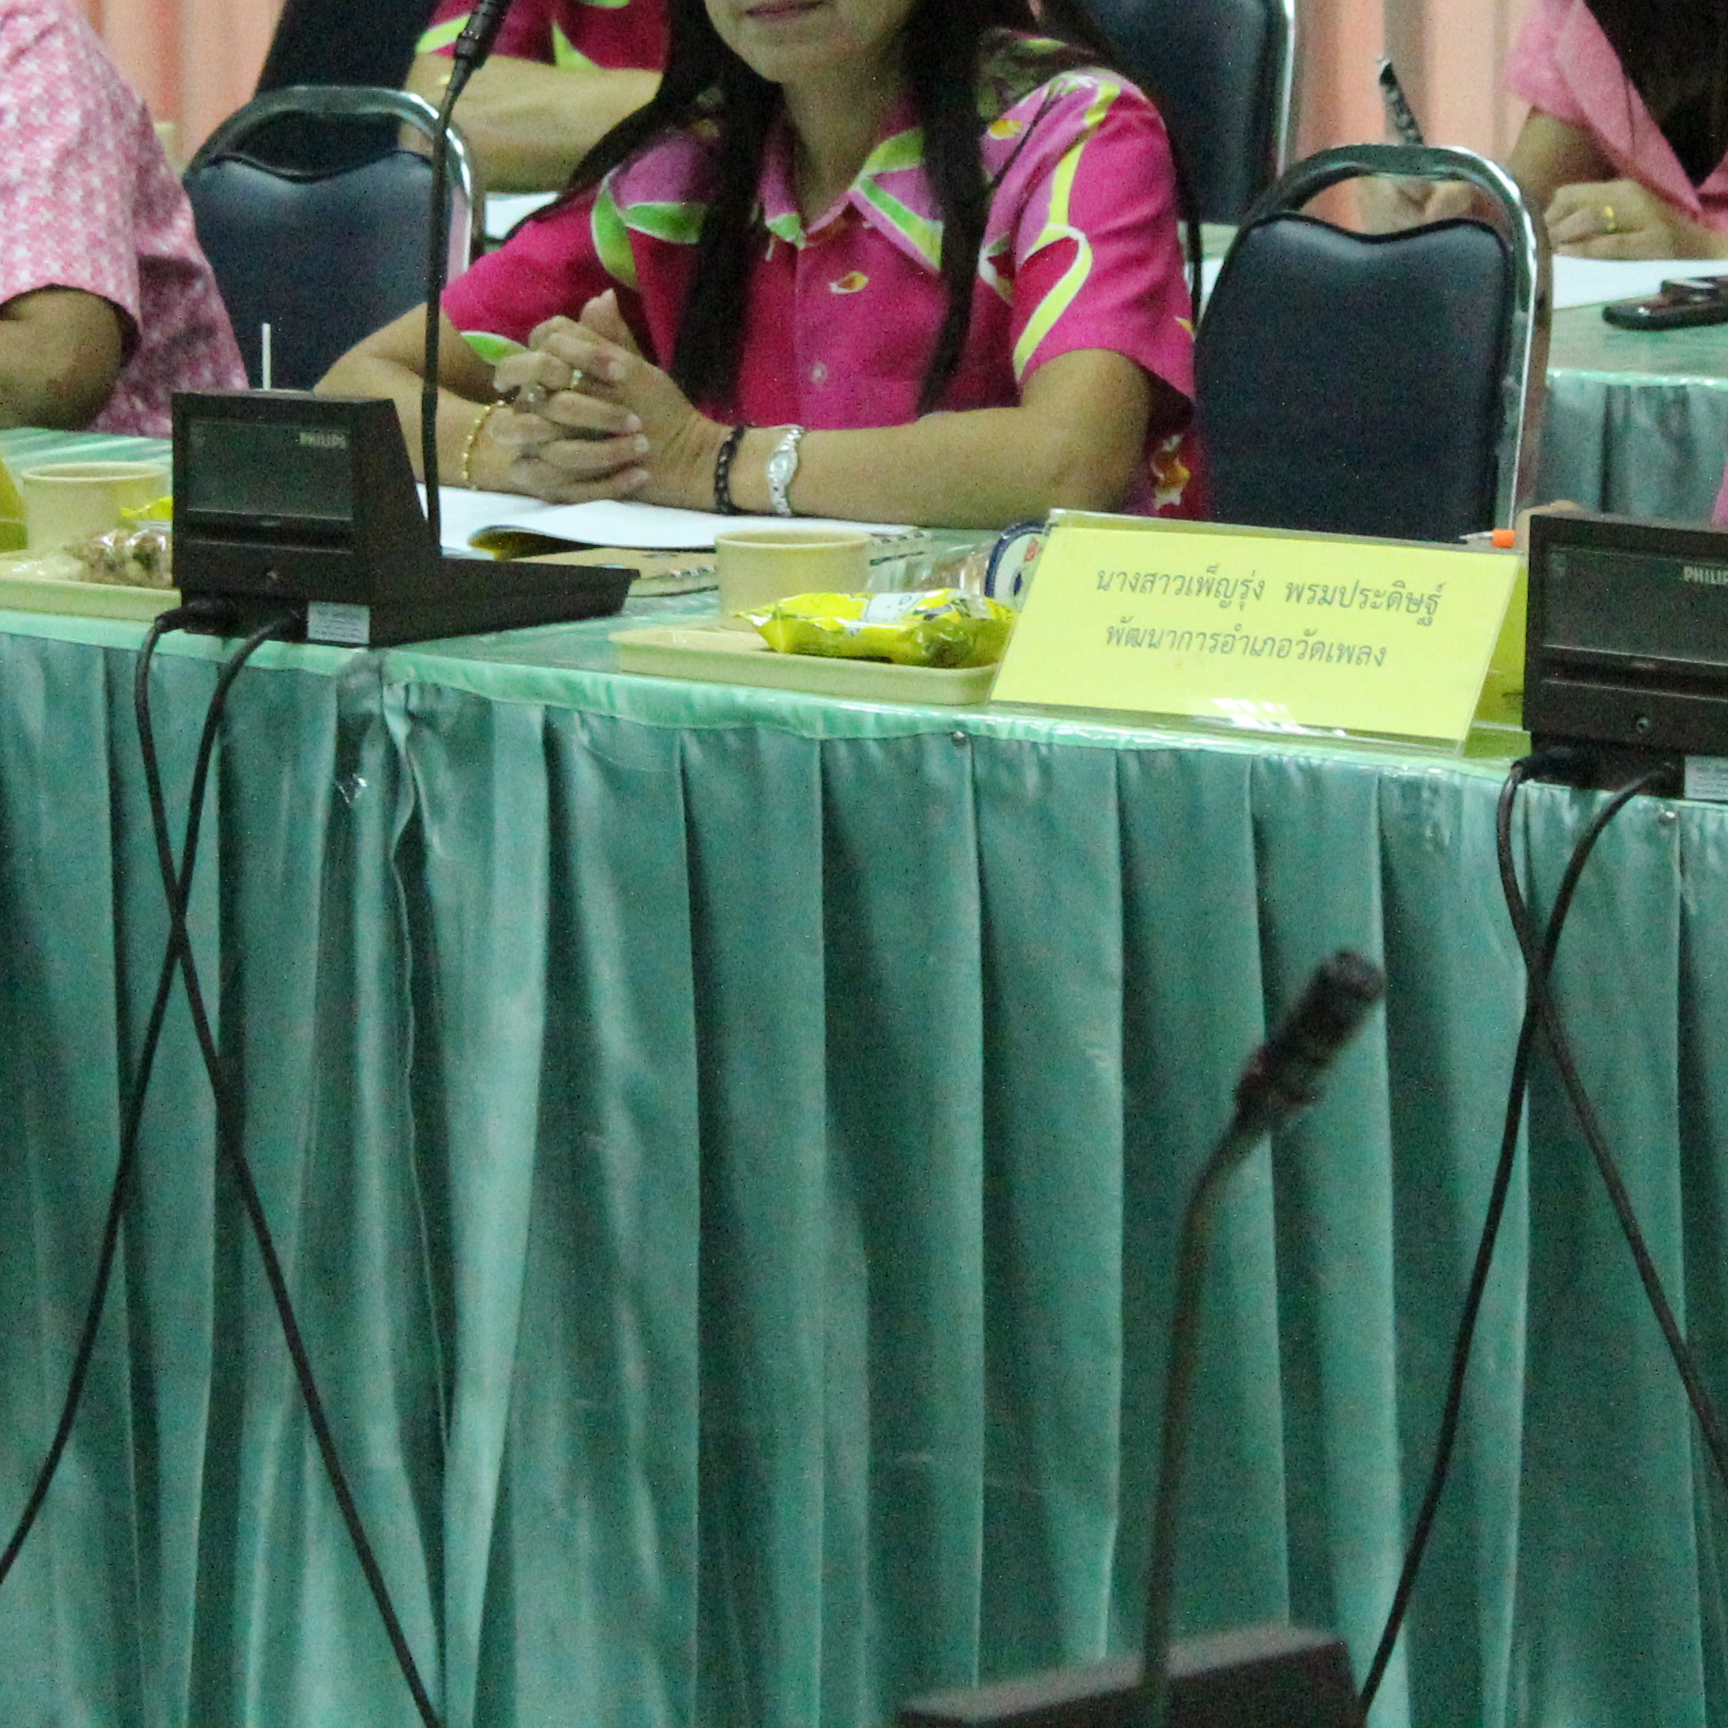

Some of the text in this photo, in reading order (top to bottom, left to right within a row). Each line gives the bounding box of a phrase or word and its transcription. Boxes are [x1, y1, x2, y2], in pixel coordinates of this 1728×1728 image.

[1096, 563, 1447, 628] นางสาวเพ็ญรุ่ง พรมประดิษฐ์
[1105, 616, 1388, 668] พัฒนาการอำเภอวัดเพลง
